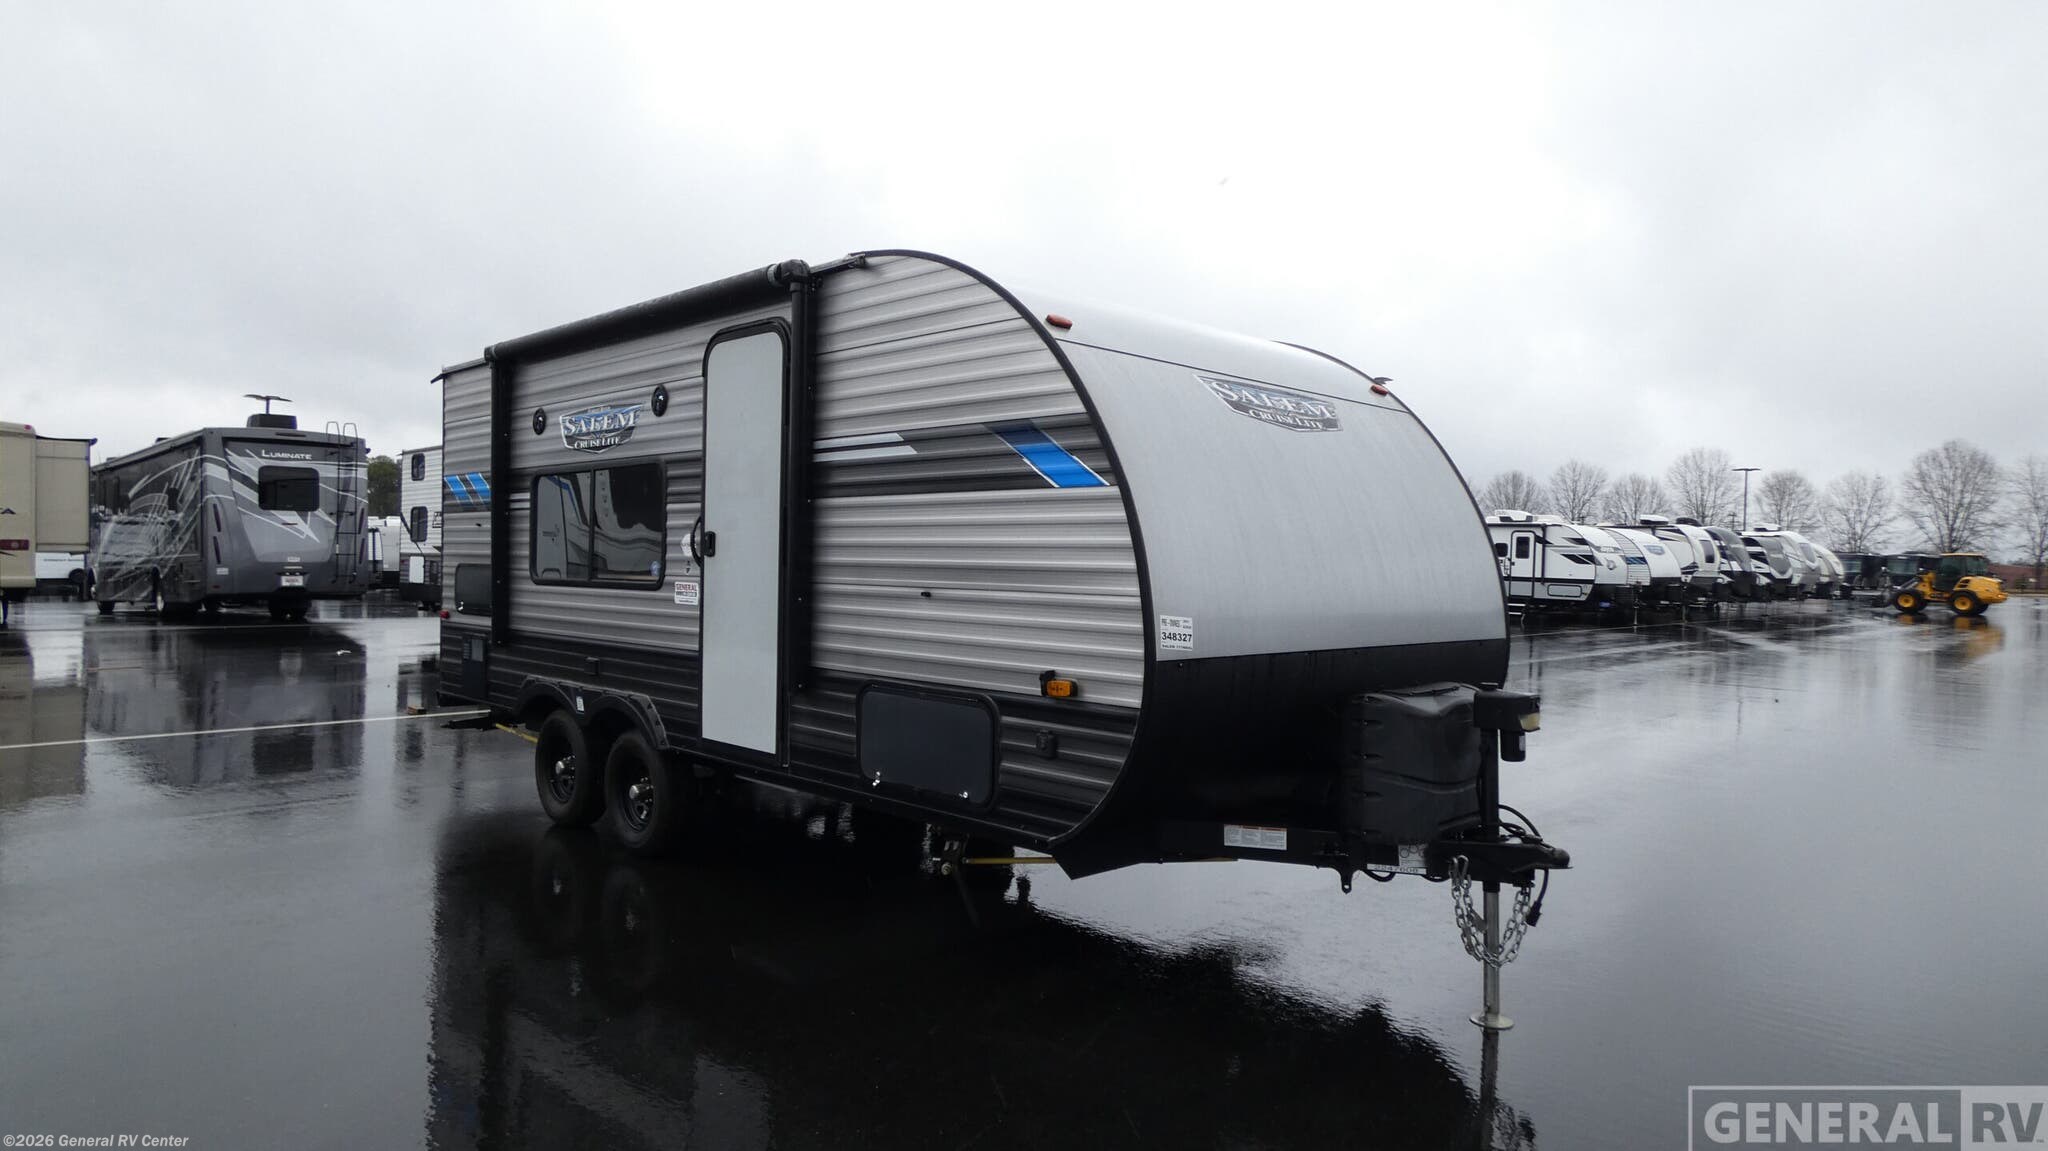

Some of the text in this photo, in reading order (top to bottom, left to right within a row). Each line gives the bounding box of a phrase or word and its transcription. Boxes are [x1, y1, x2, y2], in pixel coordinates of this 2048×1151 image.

[1211, 381, 1333, 419] SALEM
[565, 411, 636, 436] SALEM
[1161, 631, 1192, 642] 348327
